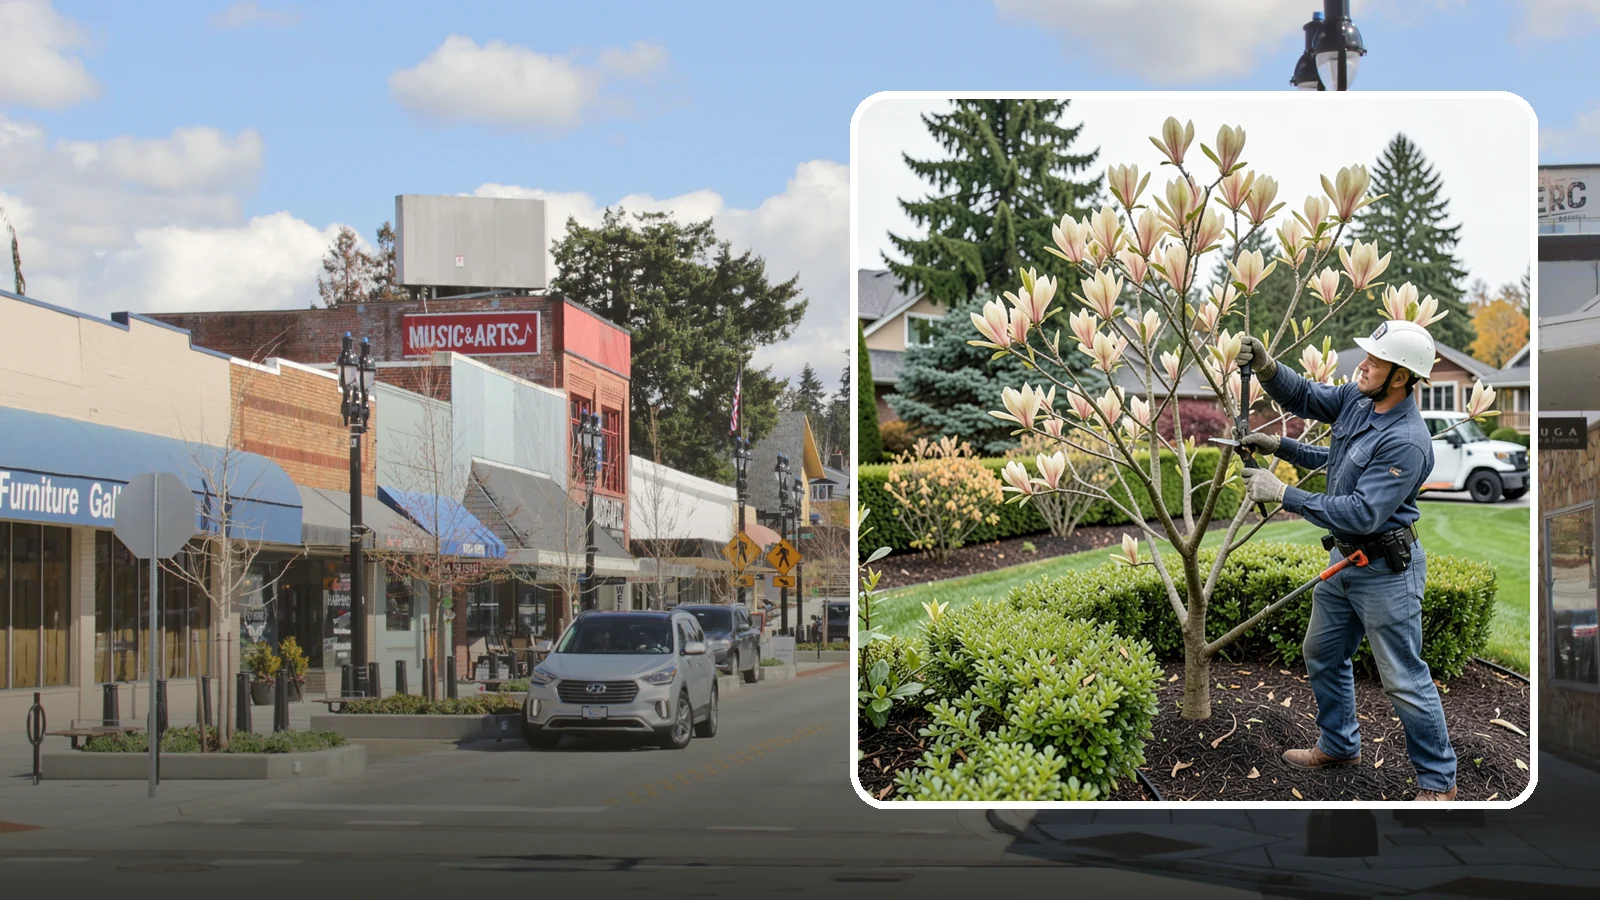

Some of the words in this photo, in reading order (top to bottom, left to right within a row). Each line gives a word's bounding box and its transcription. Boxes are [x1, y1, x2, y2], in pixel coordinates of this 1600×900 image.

[1540, 428, 1577, 436] UGA
[1552, 436, 1579, 444] Framing
[0, 471, 79, 515] Furniture
[454, 563, 479, 574] SUSHI
